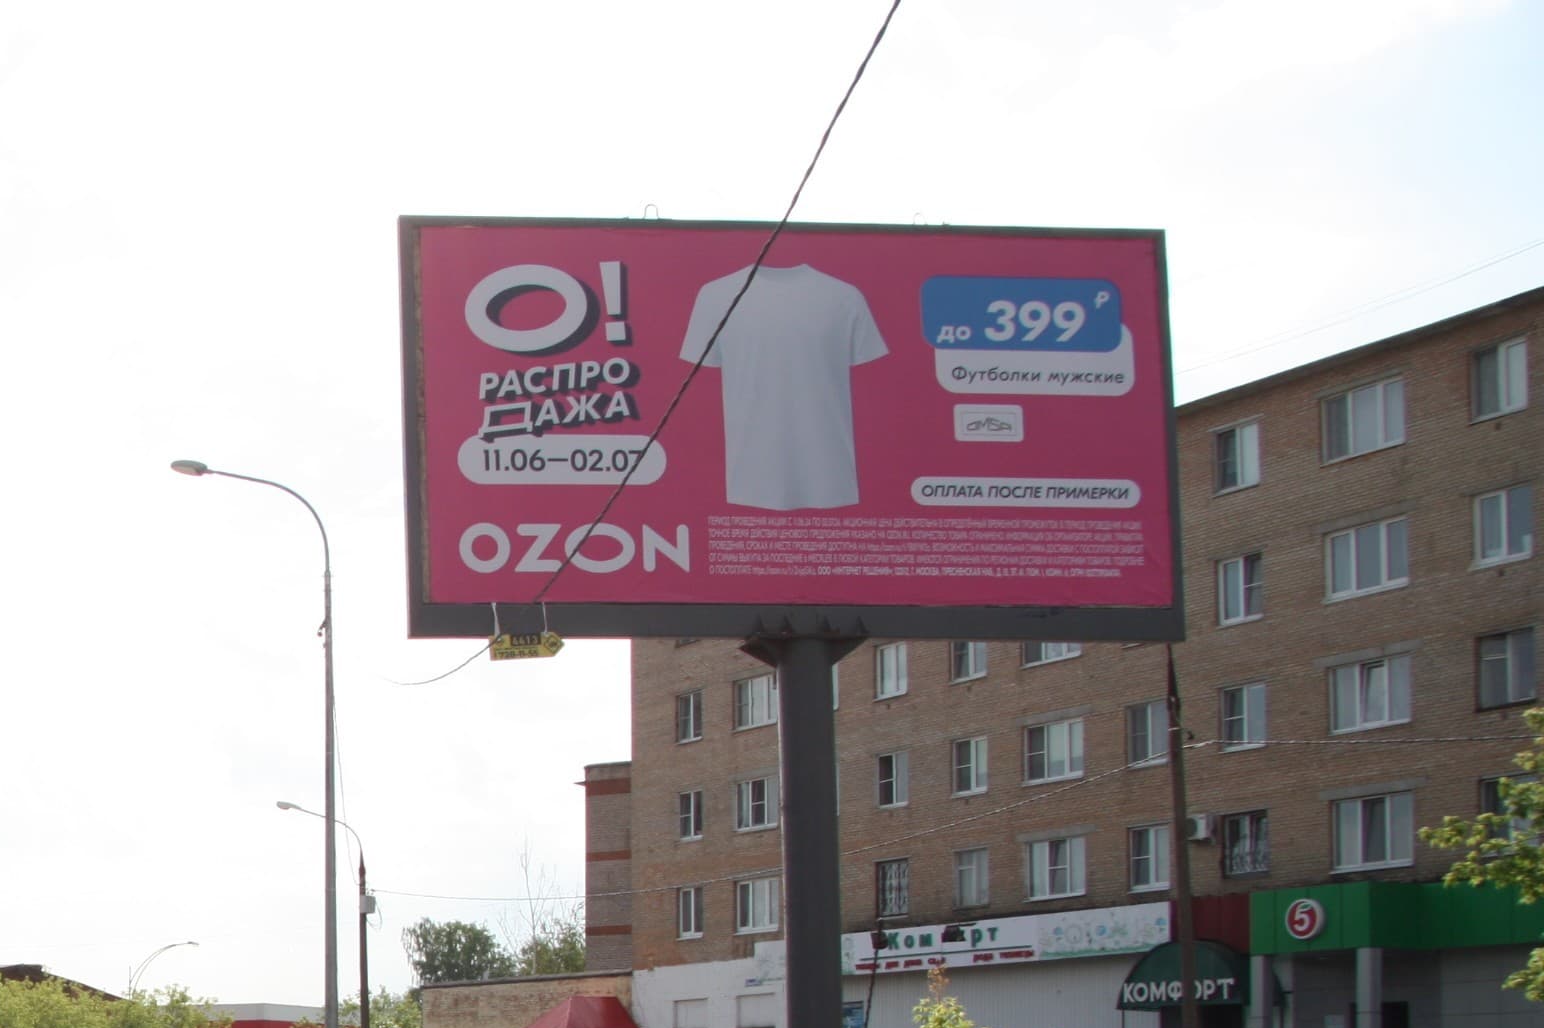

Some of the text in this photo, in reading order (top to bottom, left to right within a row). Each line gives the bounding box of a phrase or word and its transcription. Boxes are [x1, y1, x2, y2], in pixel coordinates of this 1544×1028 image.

[936, 325, 972, 343] до
[983, 300, 1086, 342] 399
[479, 356, 631, 400] РАСПРО
[951, 366, 1125, 386] Футболки мужские
[478, 391, 631, 438] ДАЖА
[921, 484, 1130, 500] ОПЛАТА ПОСЛЕ ПРИМЕРКИ
[458, 522, 691, 574] OZON
[887, 927, 999, 950] Комрт
